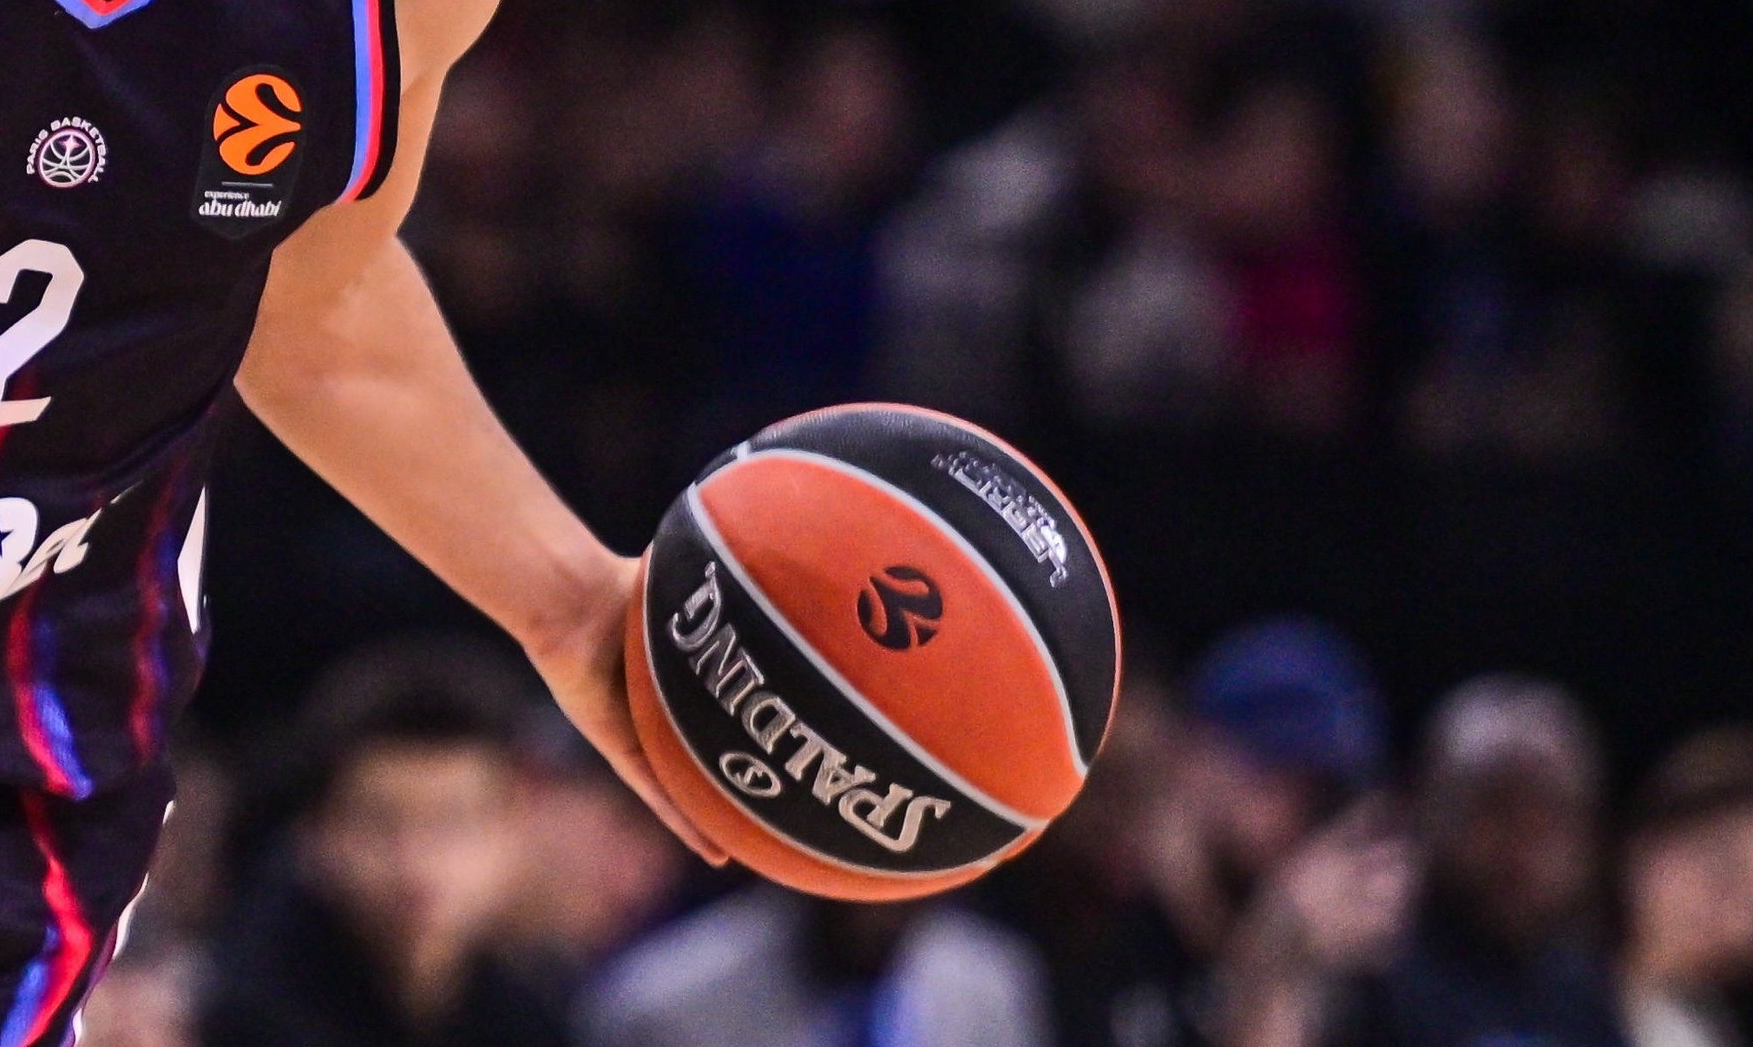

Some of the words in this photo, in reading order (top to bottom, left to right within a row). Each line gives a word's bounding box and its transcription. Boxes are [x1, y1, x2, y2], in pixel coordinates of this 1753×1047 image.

[26, 129, 49, 175] PARIS
[50, 116, 107, 183] BASKETBALL
[198, 199, 233, 216] abu
[234, 200, 282, 217] dhabi
[666, 561, 952, 853] SPALDING
